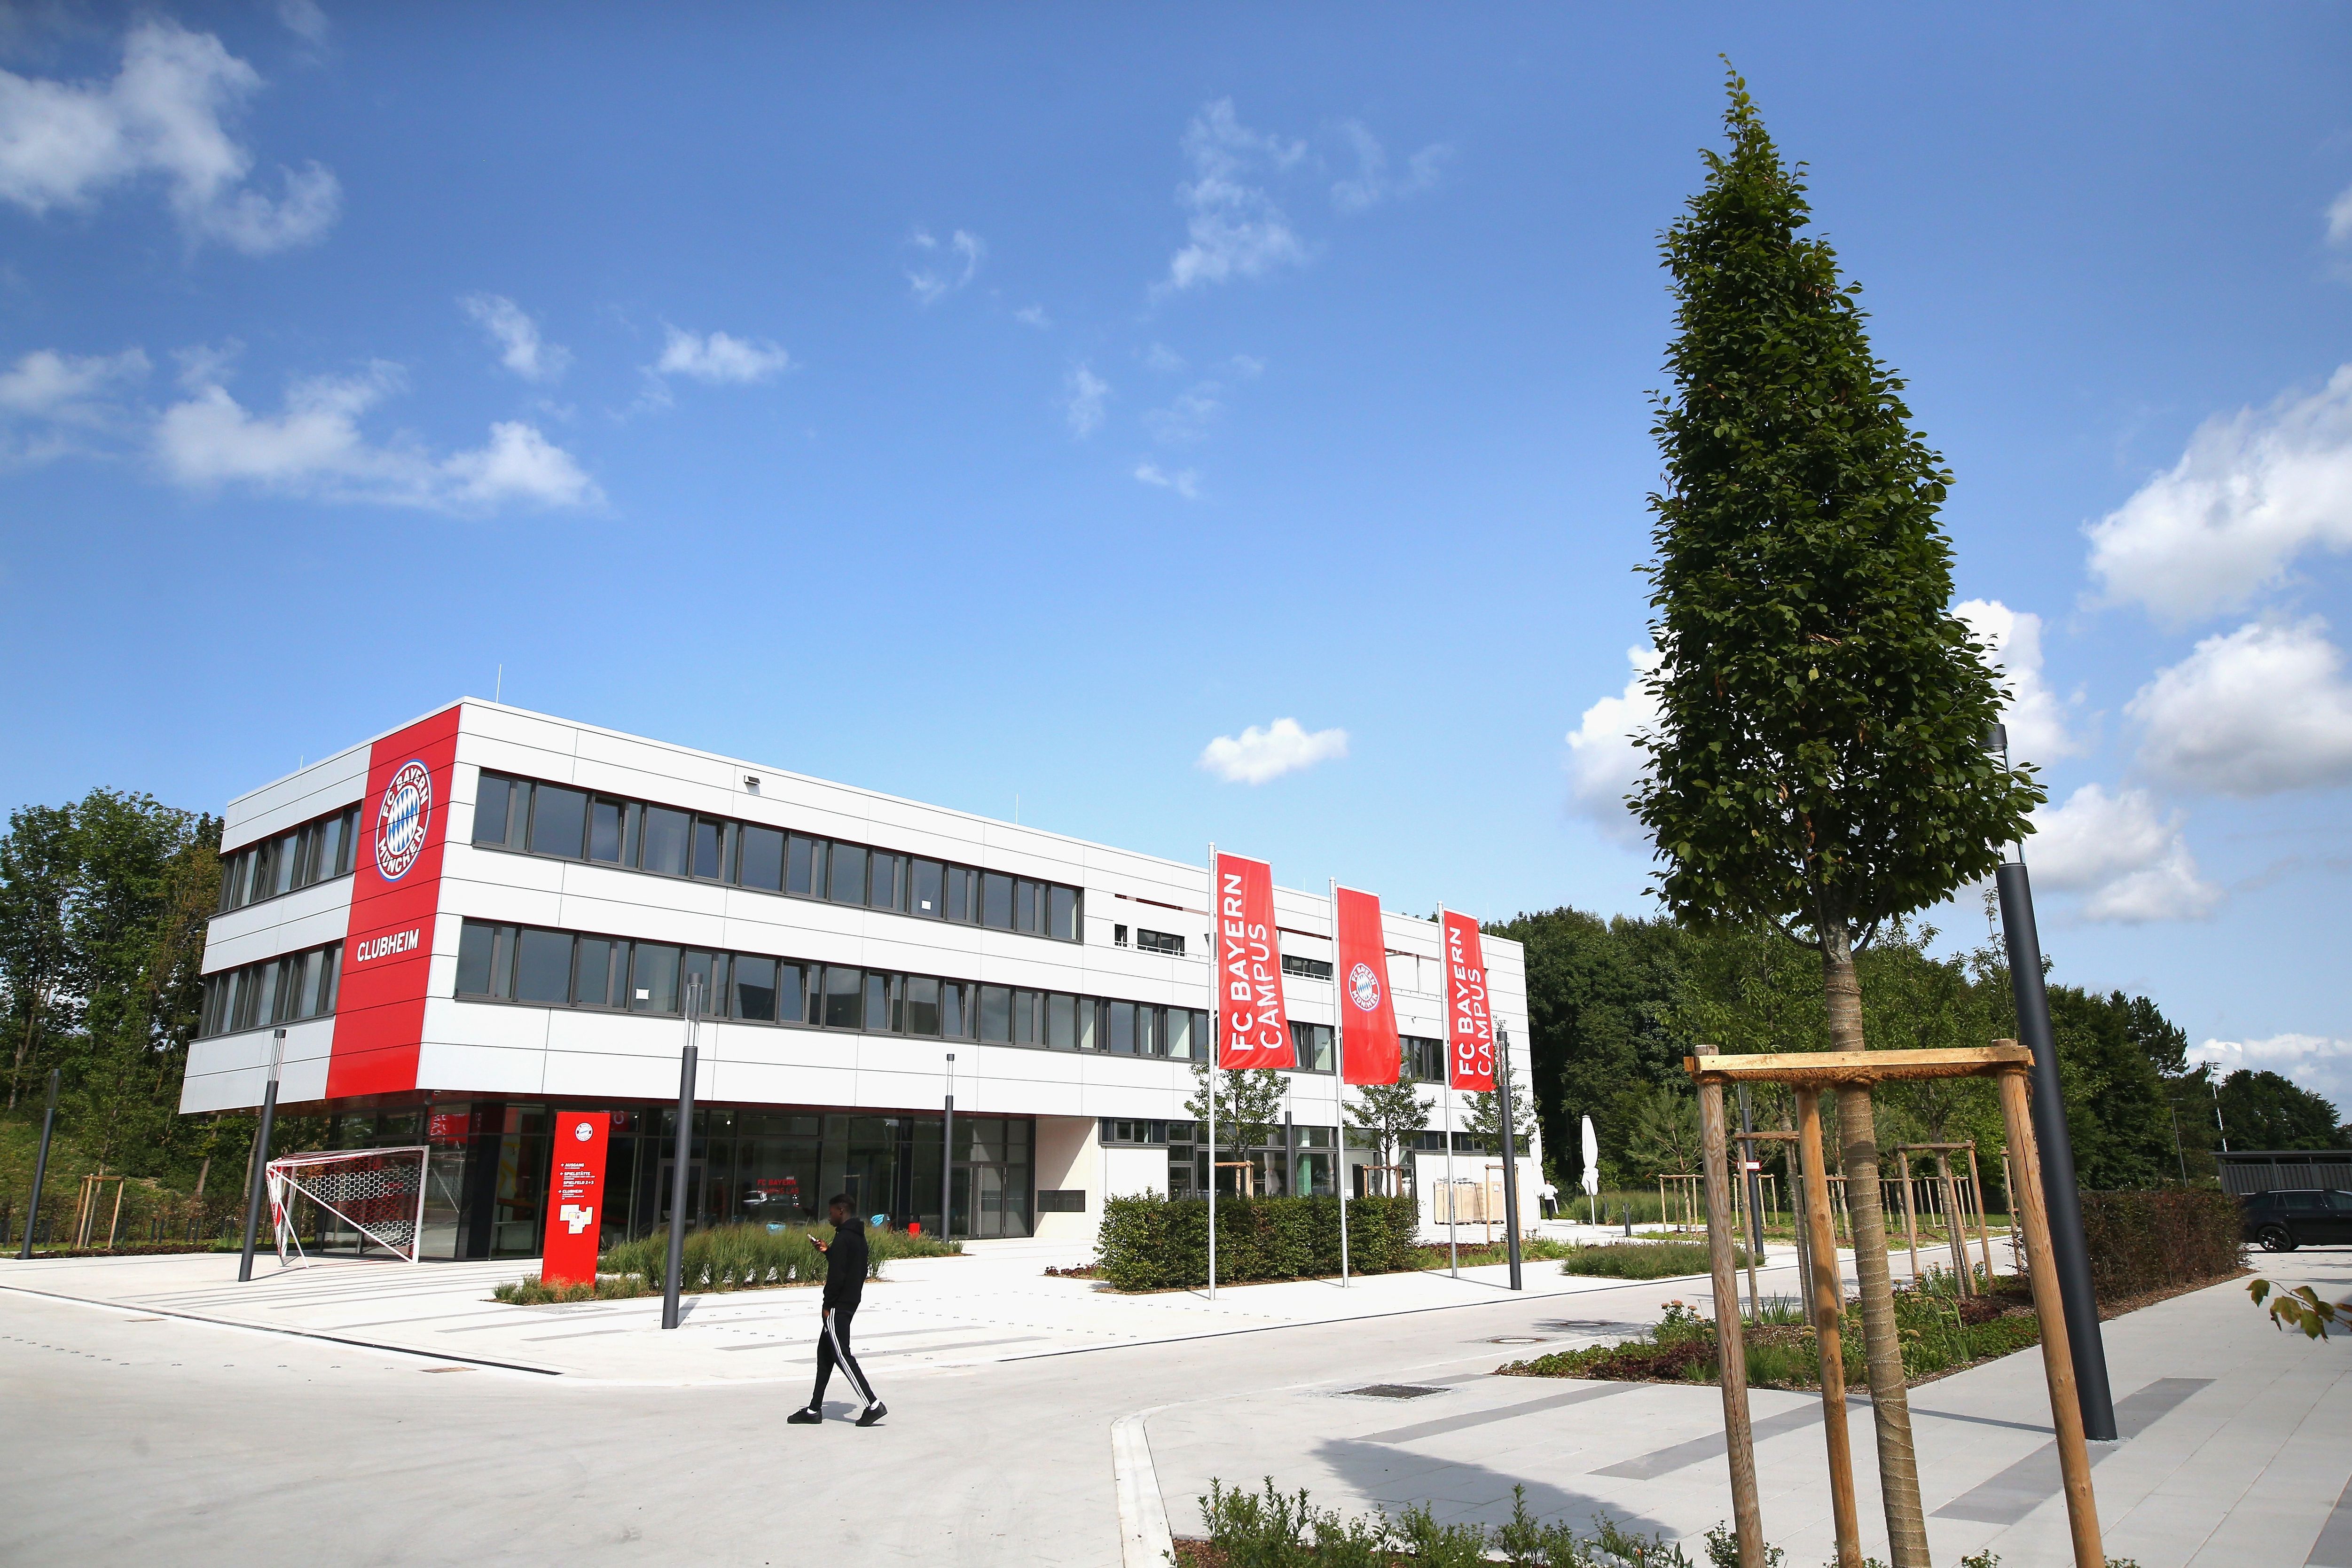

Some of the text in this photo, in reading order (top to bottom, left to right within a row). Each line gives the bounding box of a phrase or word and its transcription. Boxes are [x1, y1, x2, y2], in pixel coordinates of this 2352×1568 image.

[382, 768, 428, 818] FC BAYERN
[378, 825, 424, 873] MÜNCHEN
[357, 928, 420, 963] CLUBHEIM
[1223, 873, 1254, 1051] FC BAYERN
[1351, 971, 1358, 982] FC
[1247, 923, 1283, 1050] CAMPUS
[1449, 926, 1475, 1076] FC BAYERN
[1467, 968, 1492, 1076] CAMPUS
